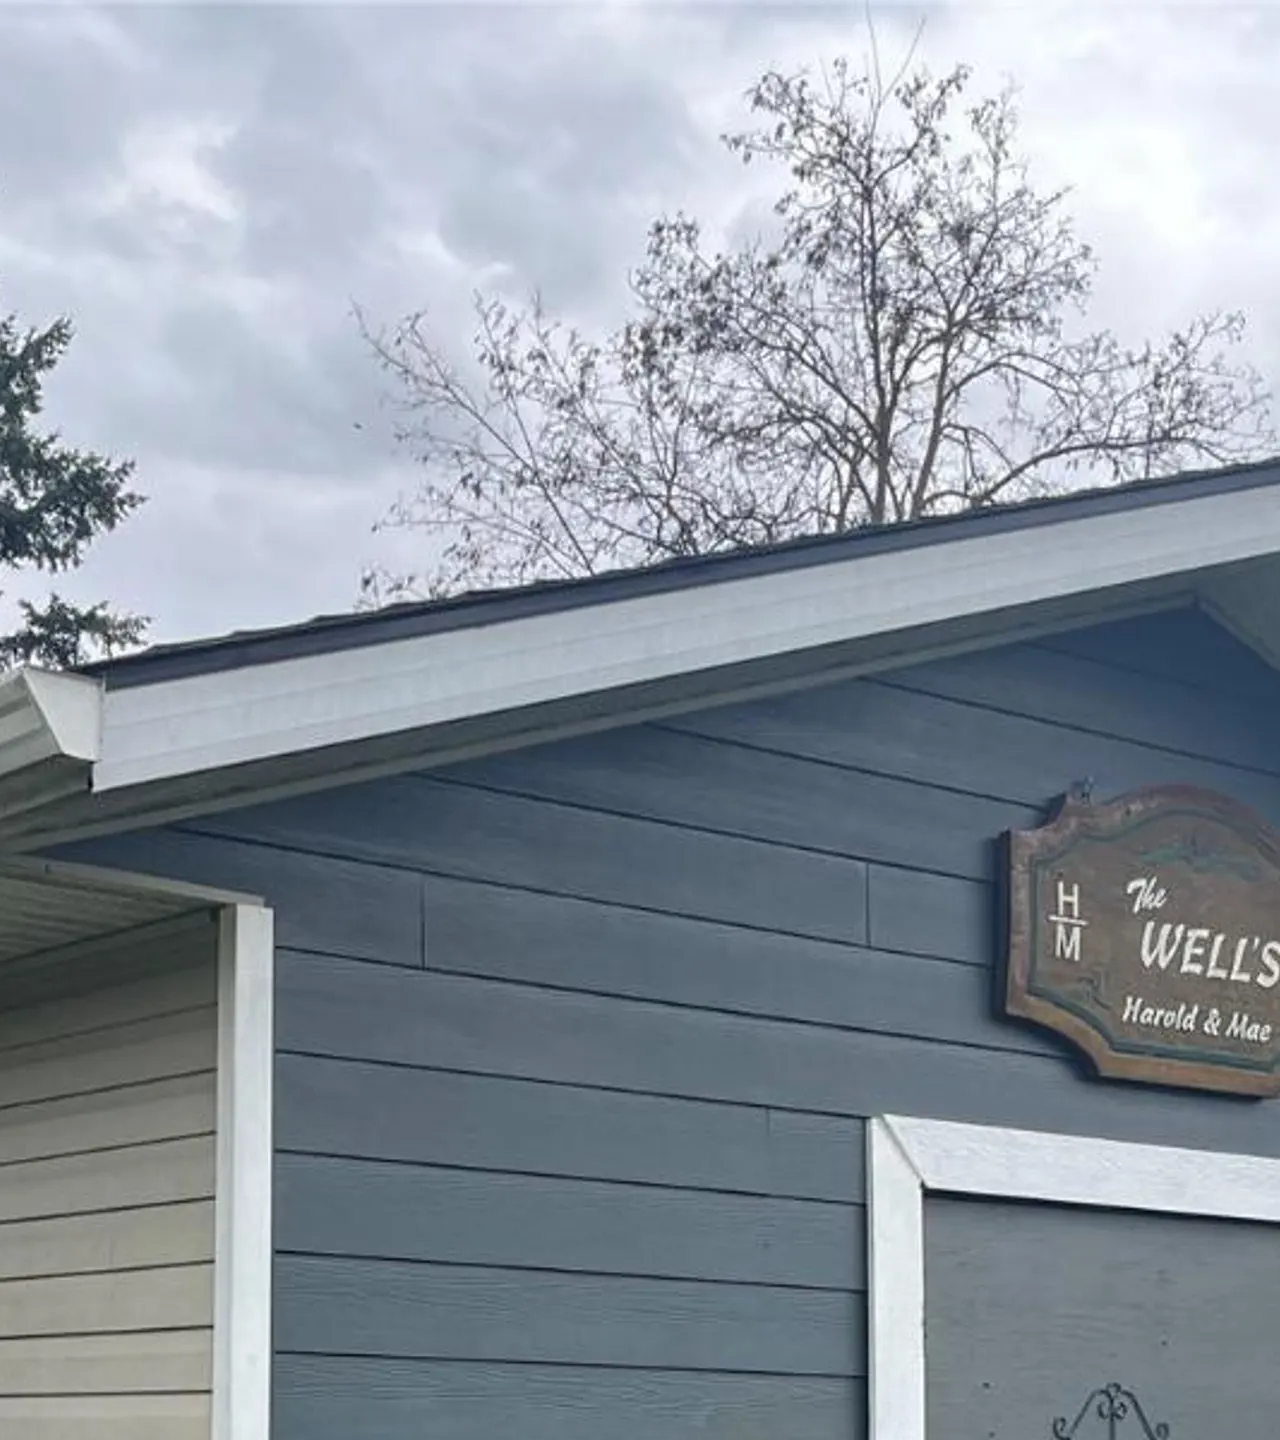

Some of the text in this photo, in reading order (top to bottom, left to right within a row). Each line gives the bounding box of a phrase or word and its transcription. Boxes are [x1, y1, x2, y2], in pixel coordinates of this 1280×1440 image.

[1057, 881, 1079, 917] H
[1126, 876, 1167, 913] The
[1055, 925, 1080, 961] M
[1122, 996, 1272, 1042] Harold & Mae
